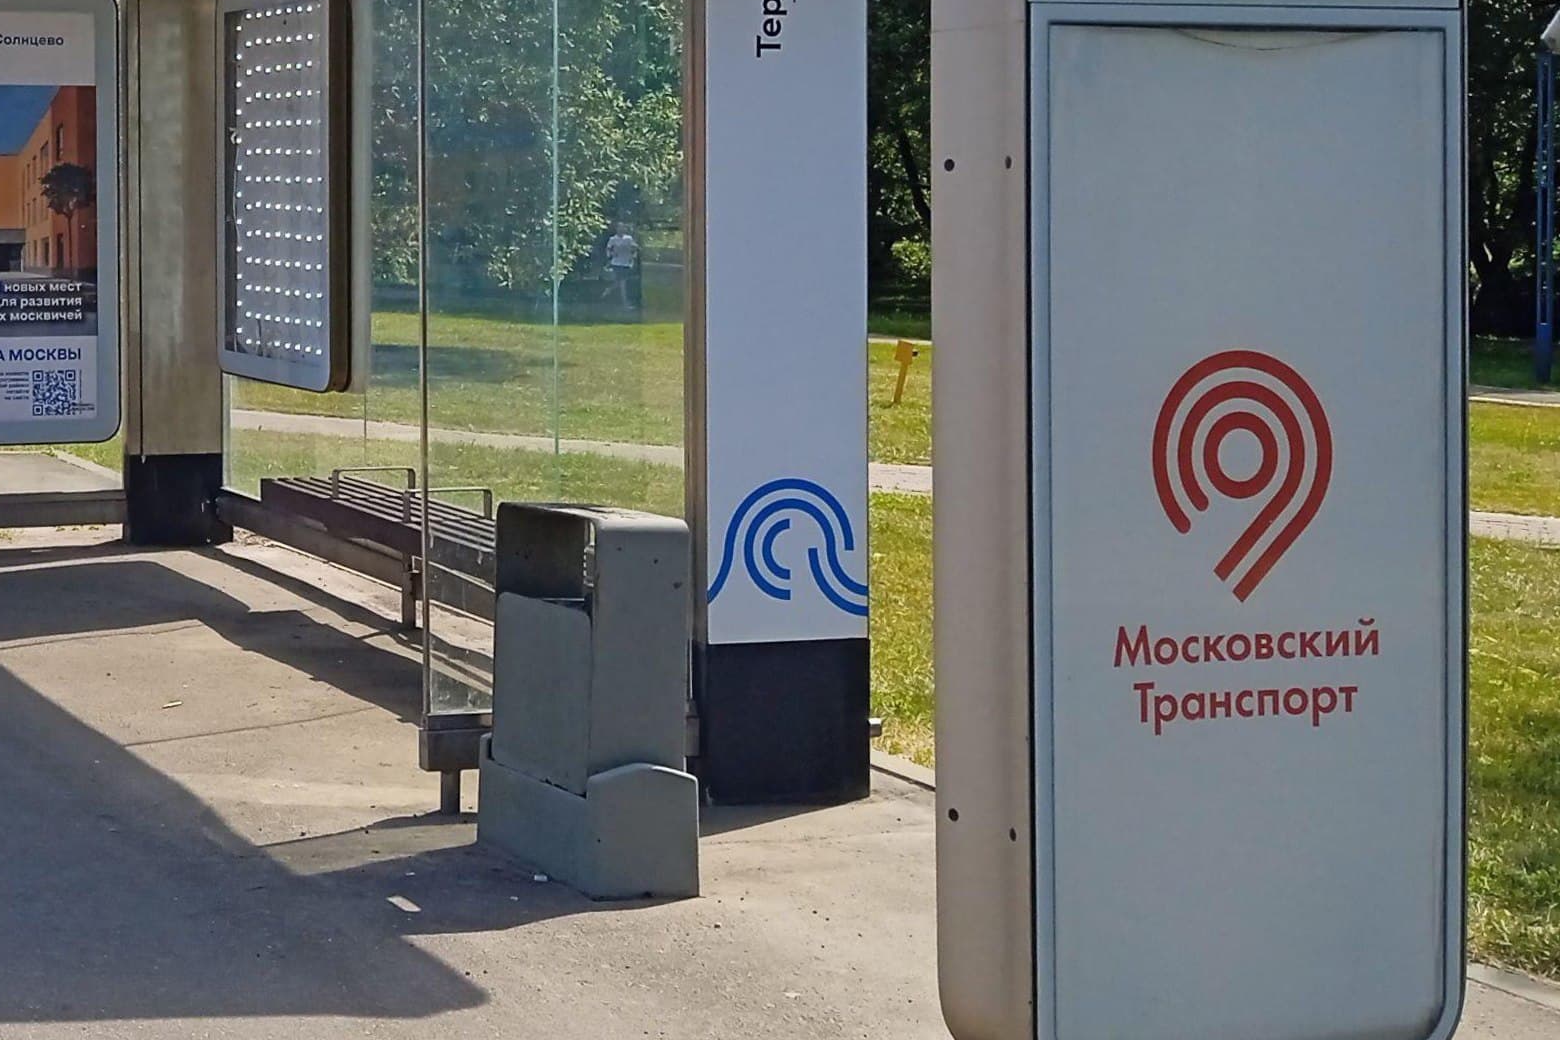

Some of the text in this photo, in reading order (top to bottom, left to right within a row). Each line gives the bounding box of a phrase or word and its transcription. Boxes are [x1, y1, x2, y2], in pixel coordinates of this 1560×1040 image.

[4, 282, 46, 293] новых
[49, 282, 82, 292] мест
[20, 297, 82, 309] развития
[9, 308, 82, 322] москвичей
[9, 348, 81, 361] МОСКВЫ
[1114, 616, 1380, 668] Московский
[1134, 681, 1358, 736] Транспорт
